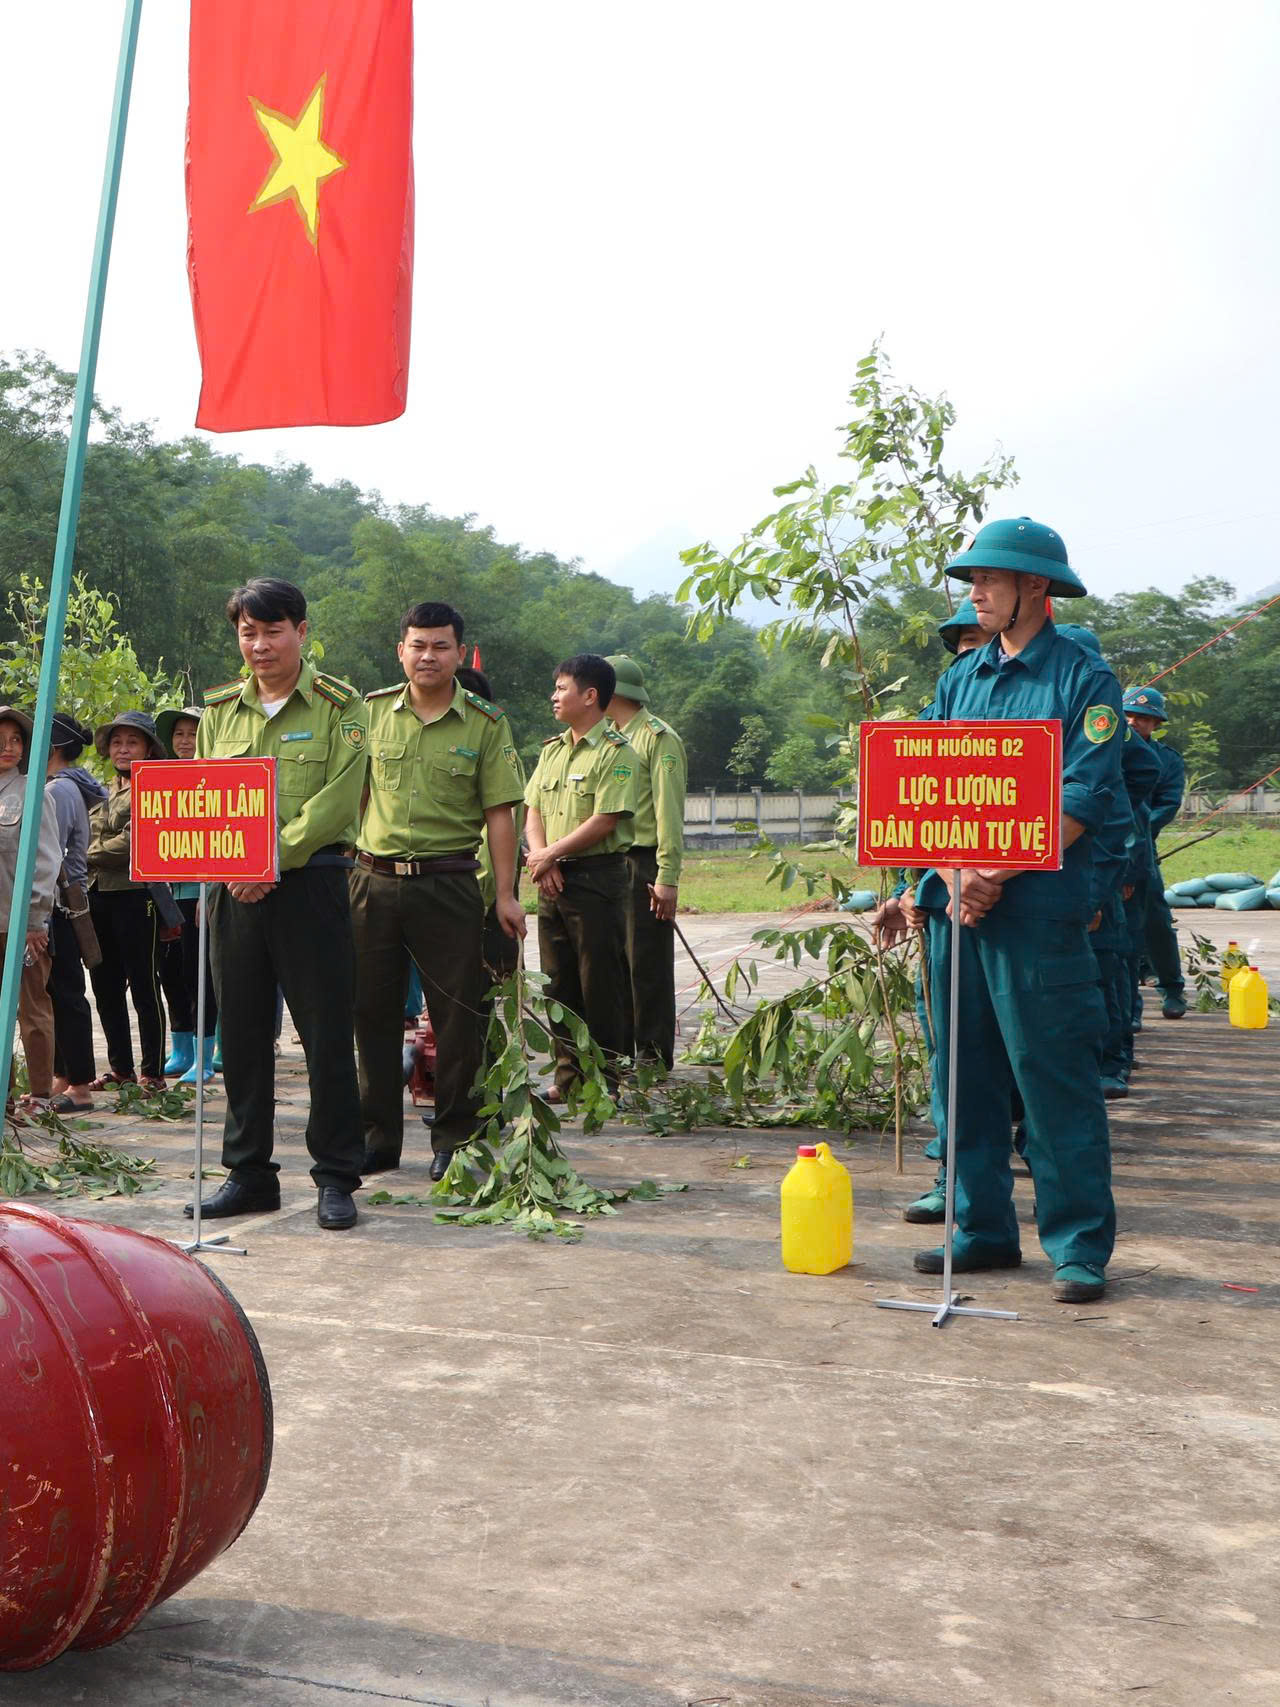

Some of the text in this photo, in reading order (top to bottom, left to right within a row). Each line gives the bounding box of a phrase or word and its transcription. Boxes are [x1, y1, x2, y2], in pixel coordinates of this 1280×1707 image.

[893, 732, 1024, 757] TÌNH HUỐNG 02
[140, 778, 265, 825] HẠT KIỂM LÂM
[898, 774, 1017, 812] LỰC LƯỢNG
[158, 824, 246, 862] QUAN HÓA
[870, 814, 1046, 857] DÂN QUÂN TỰ VỆ
